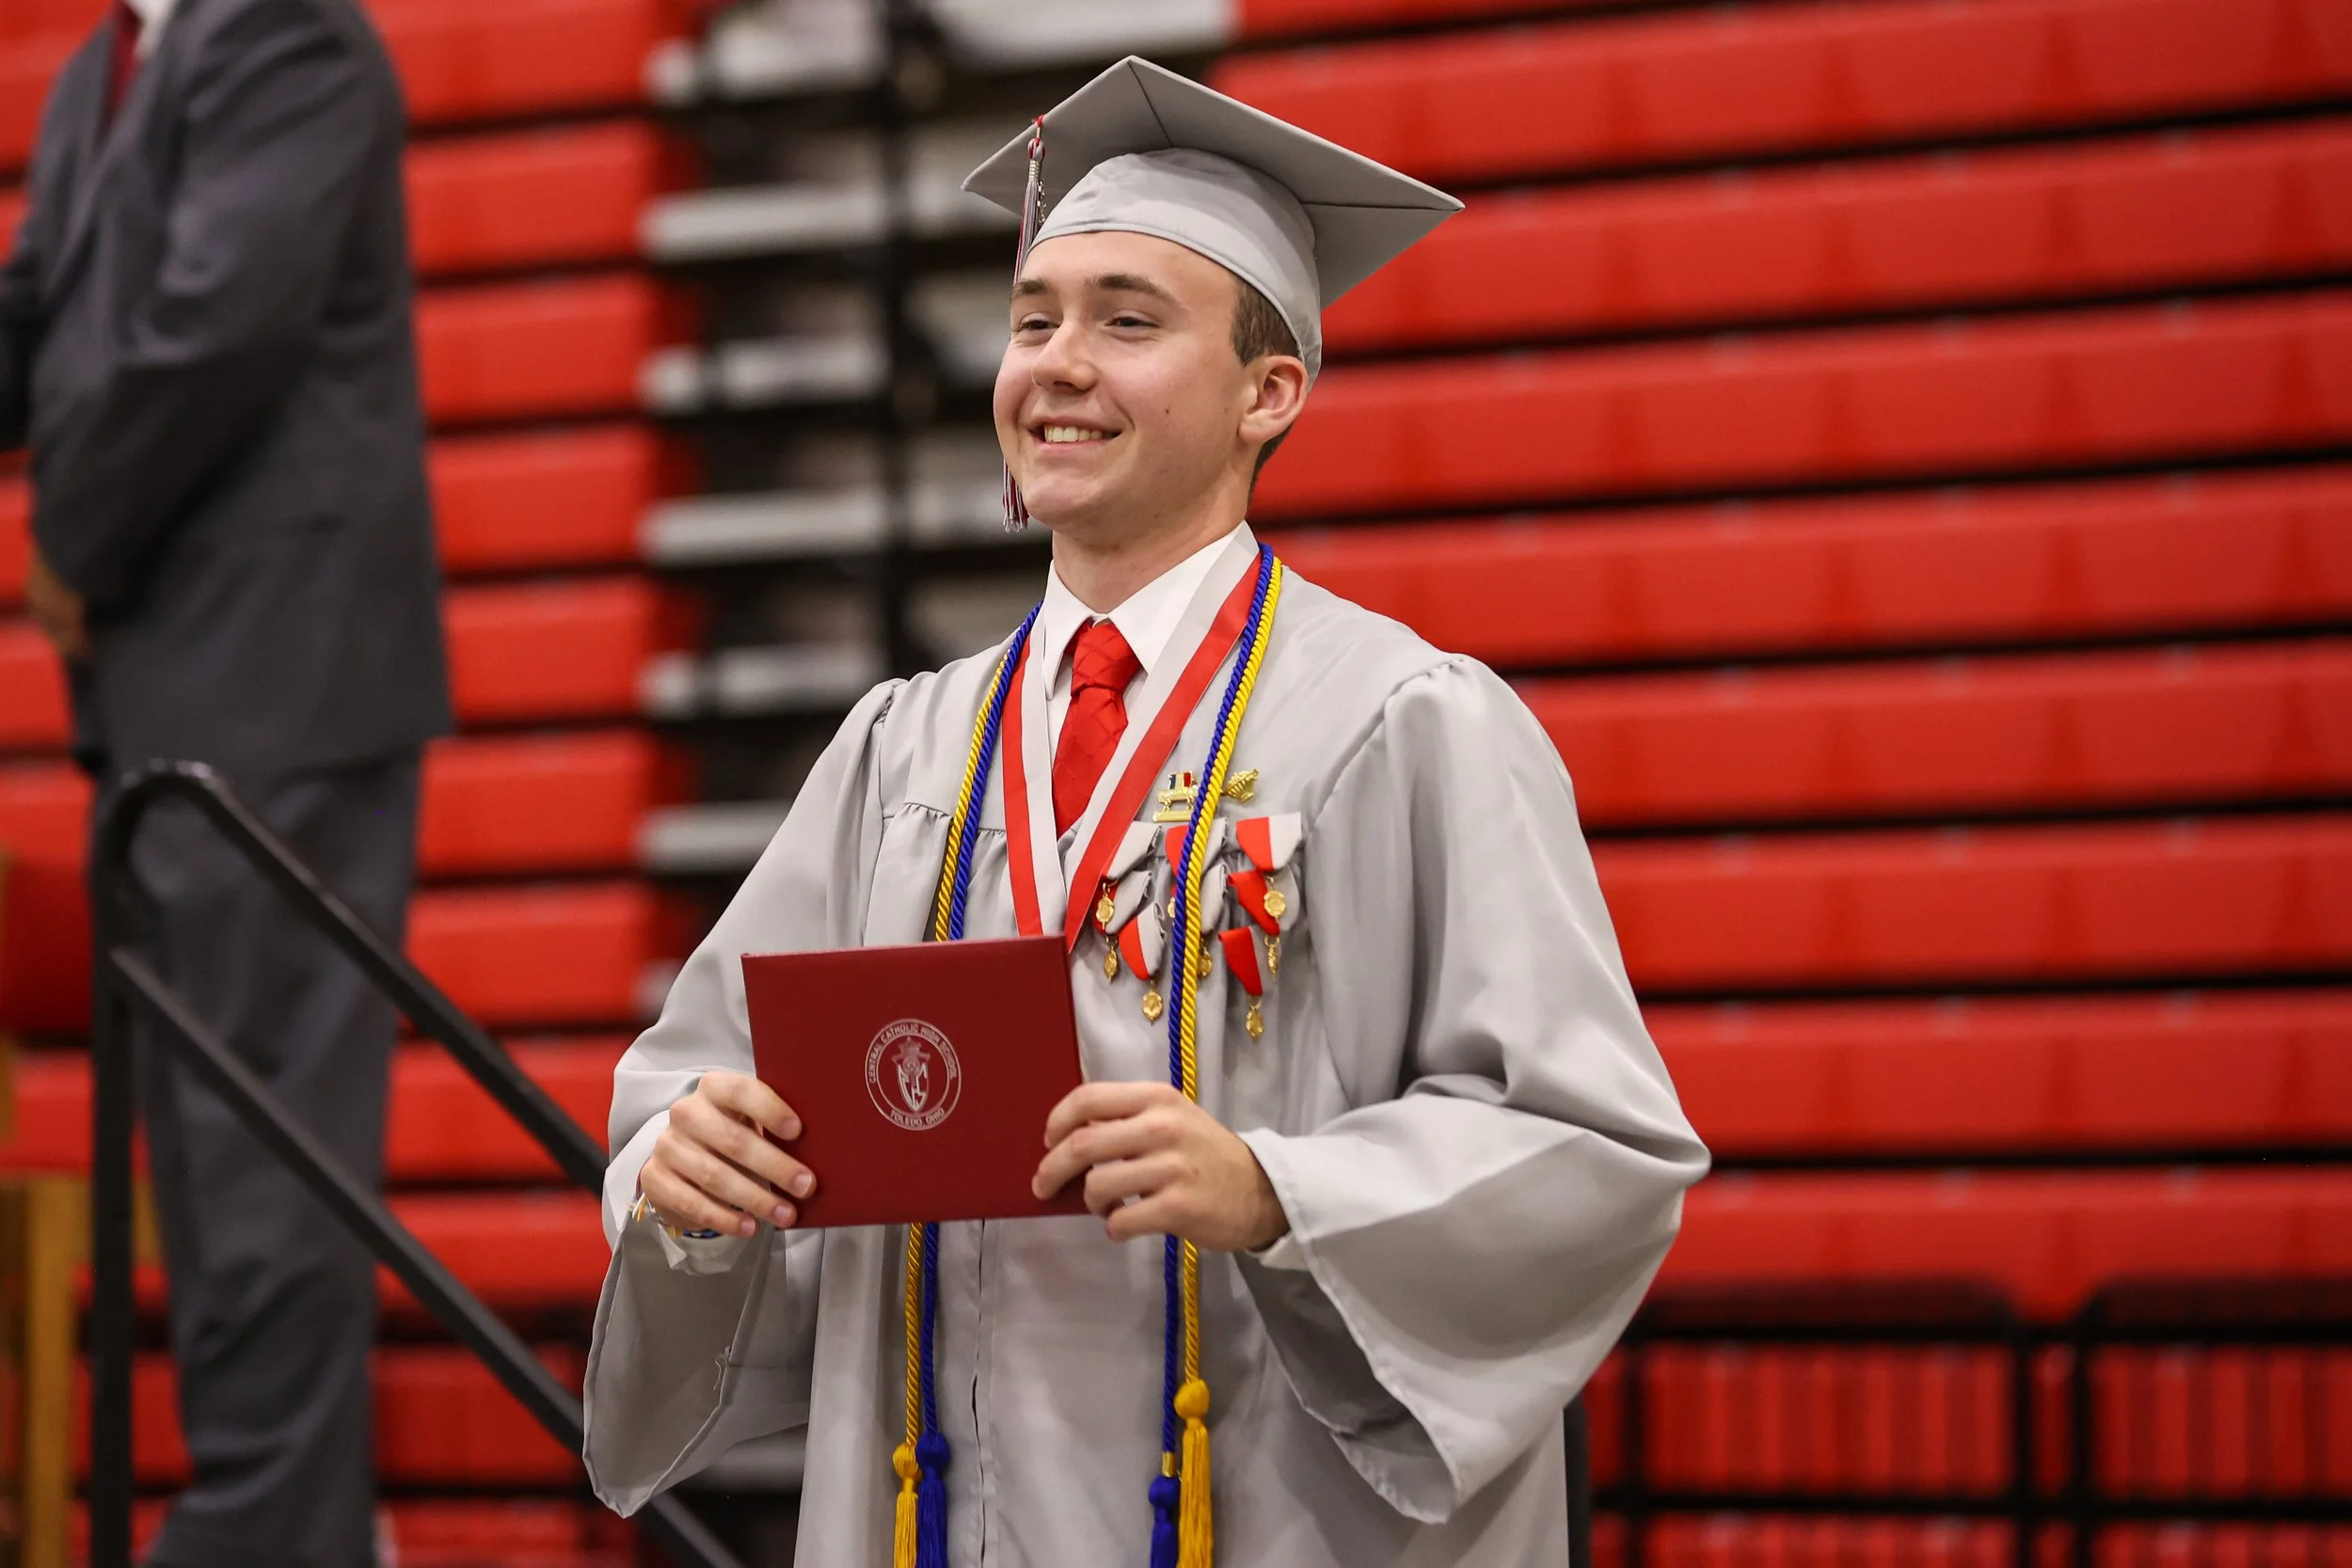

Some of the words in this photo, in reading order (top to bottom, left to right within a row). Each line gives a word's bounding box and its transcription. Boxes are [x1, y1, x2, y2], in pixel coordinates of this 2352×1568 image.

[868, 1043, 883, 1084] CENTRAL
[881, 1022, 919, 1043] CATHOLIC
[926, 1107, 945, 1125] OHIO
